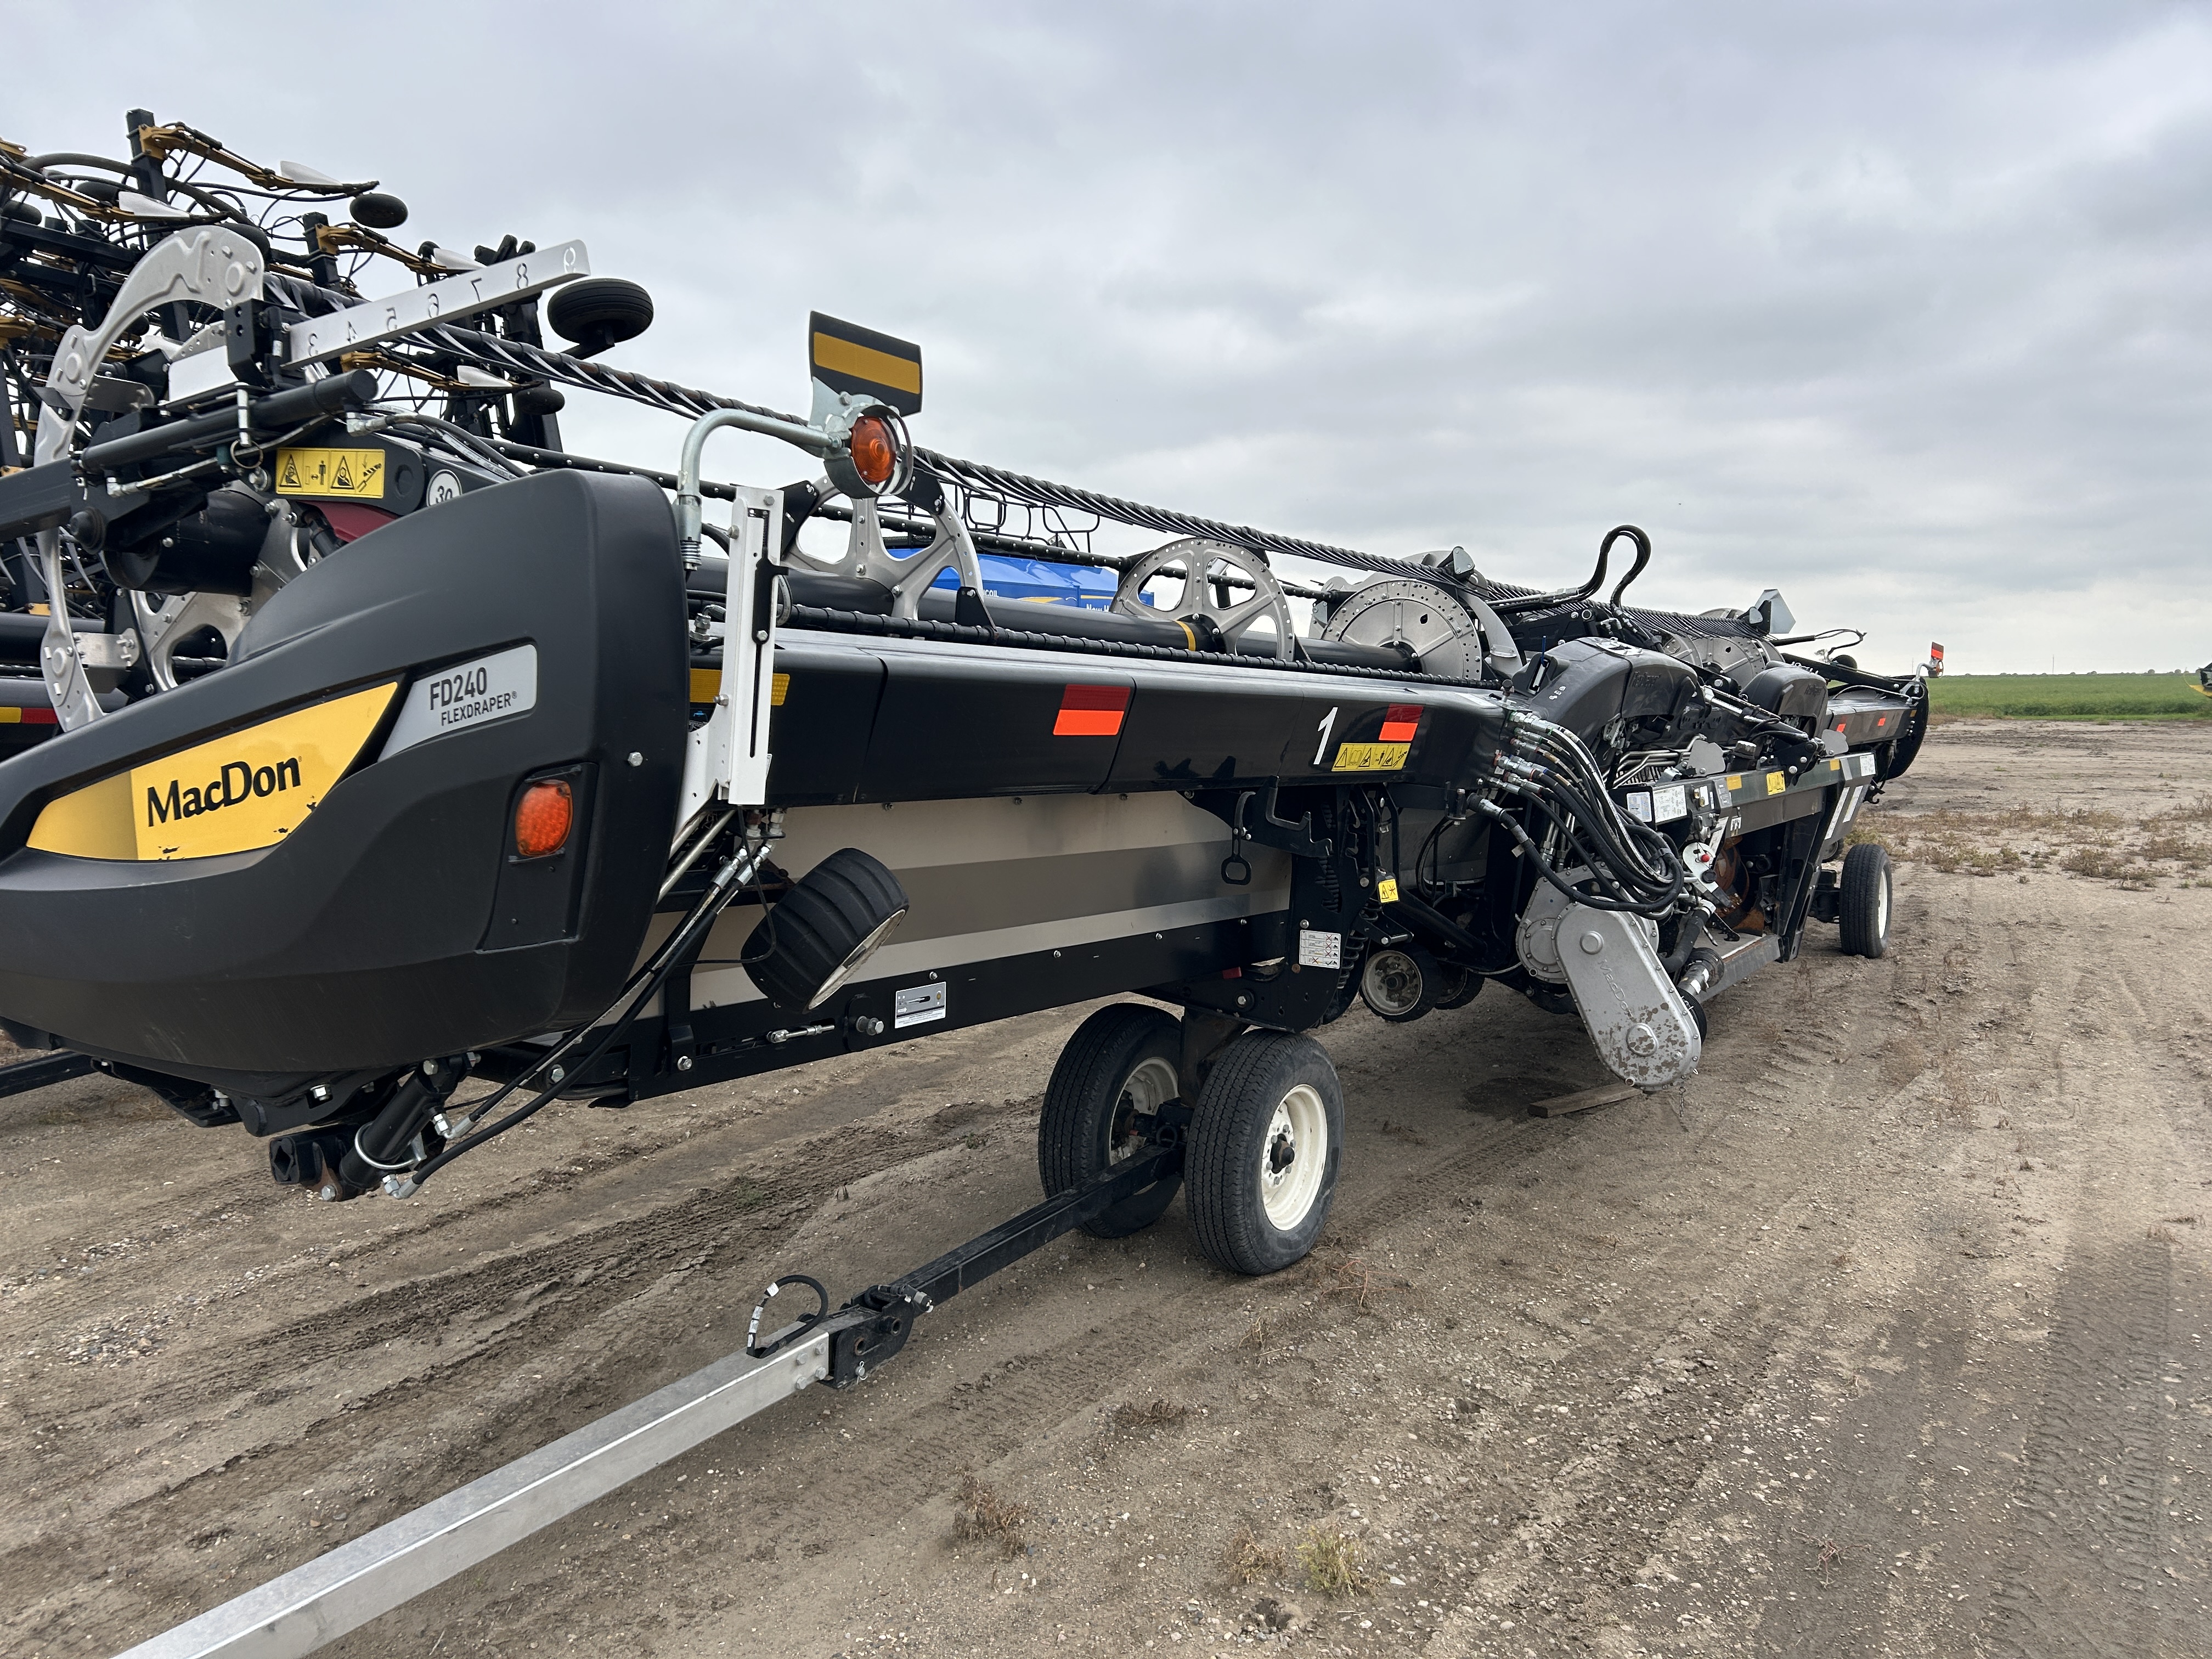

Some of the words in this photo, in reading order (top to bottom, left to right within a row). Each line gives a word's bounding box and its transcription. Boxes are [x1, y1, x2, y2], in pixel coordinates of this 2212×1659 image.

[436, 486, 453, 504] 30
[430, 667, 488, 710] FD240
[1313, 707, 1339, 765] 1
[147, 757, 301, 827] MacDon
